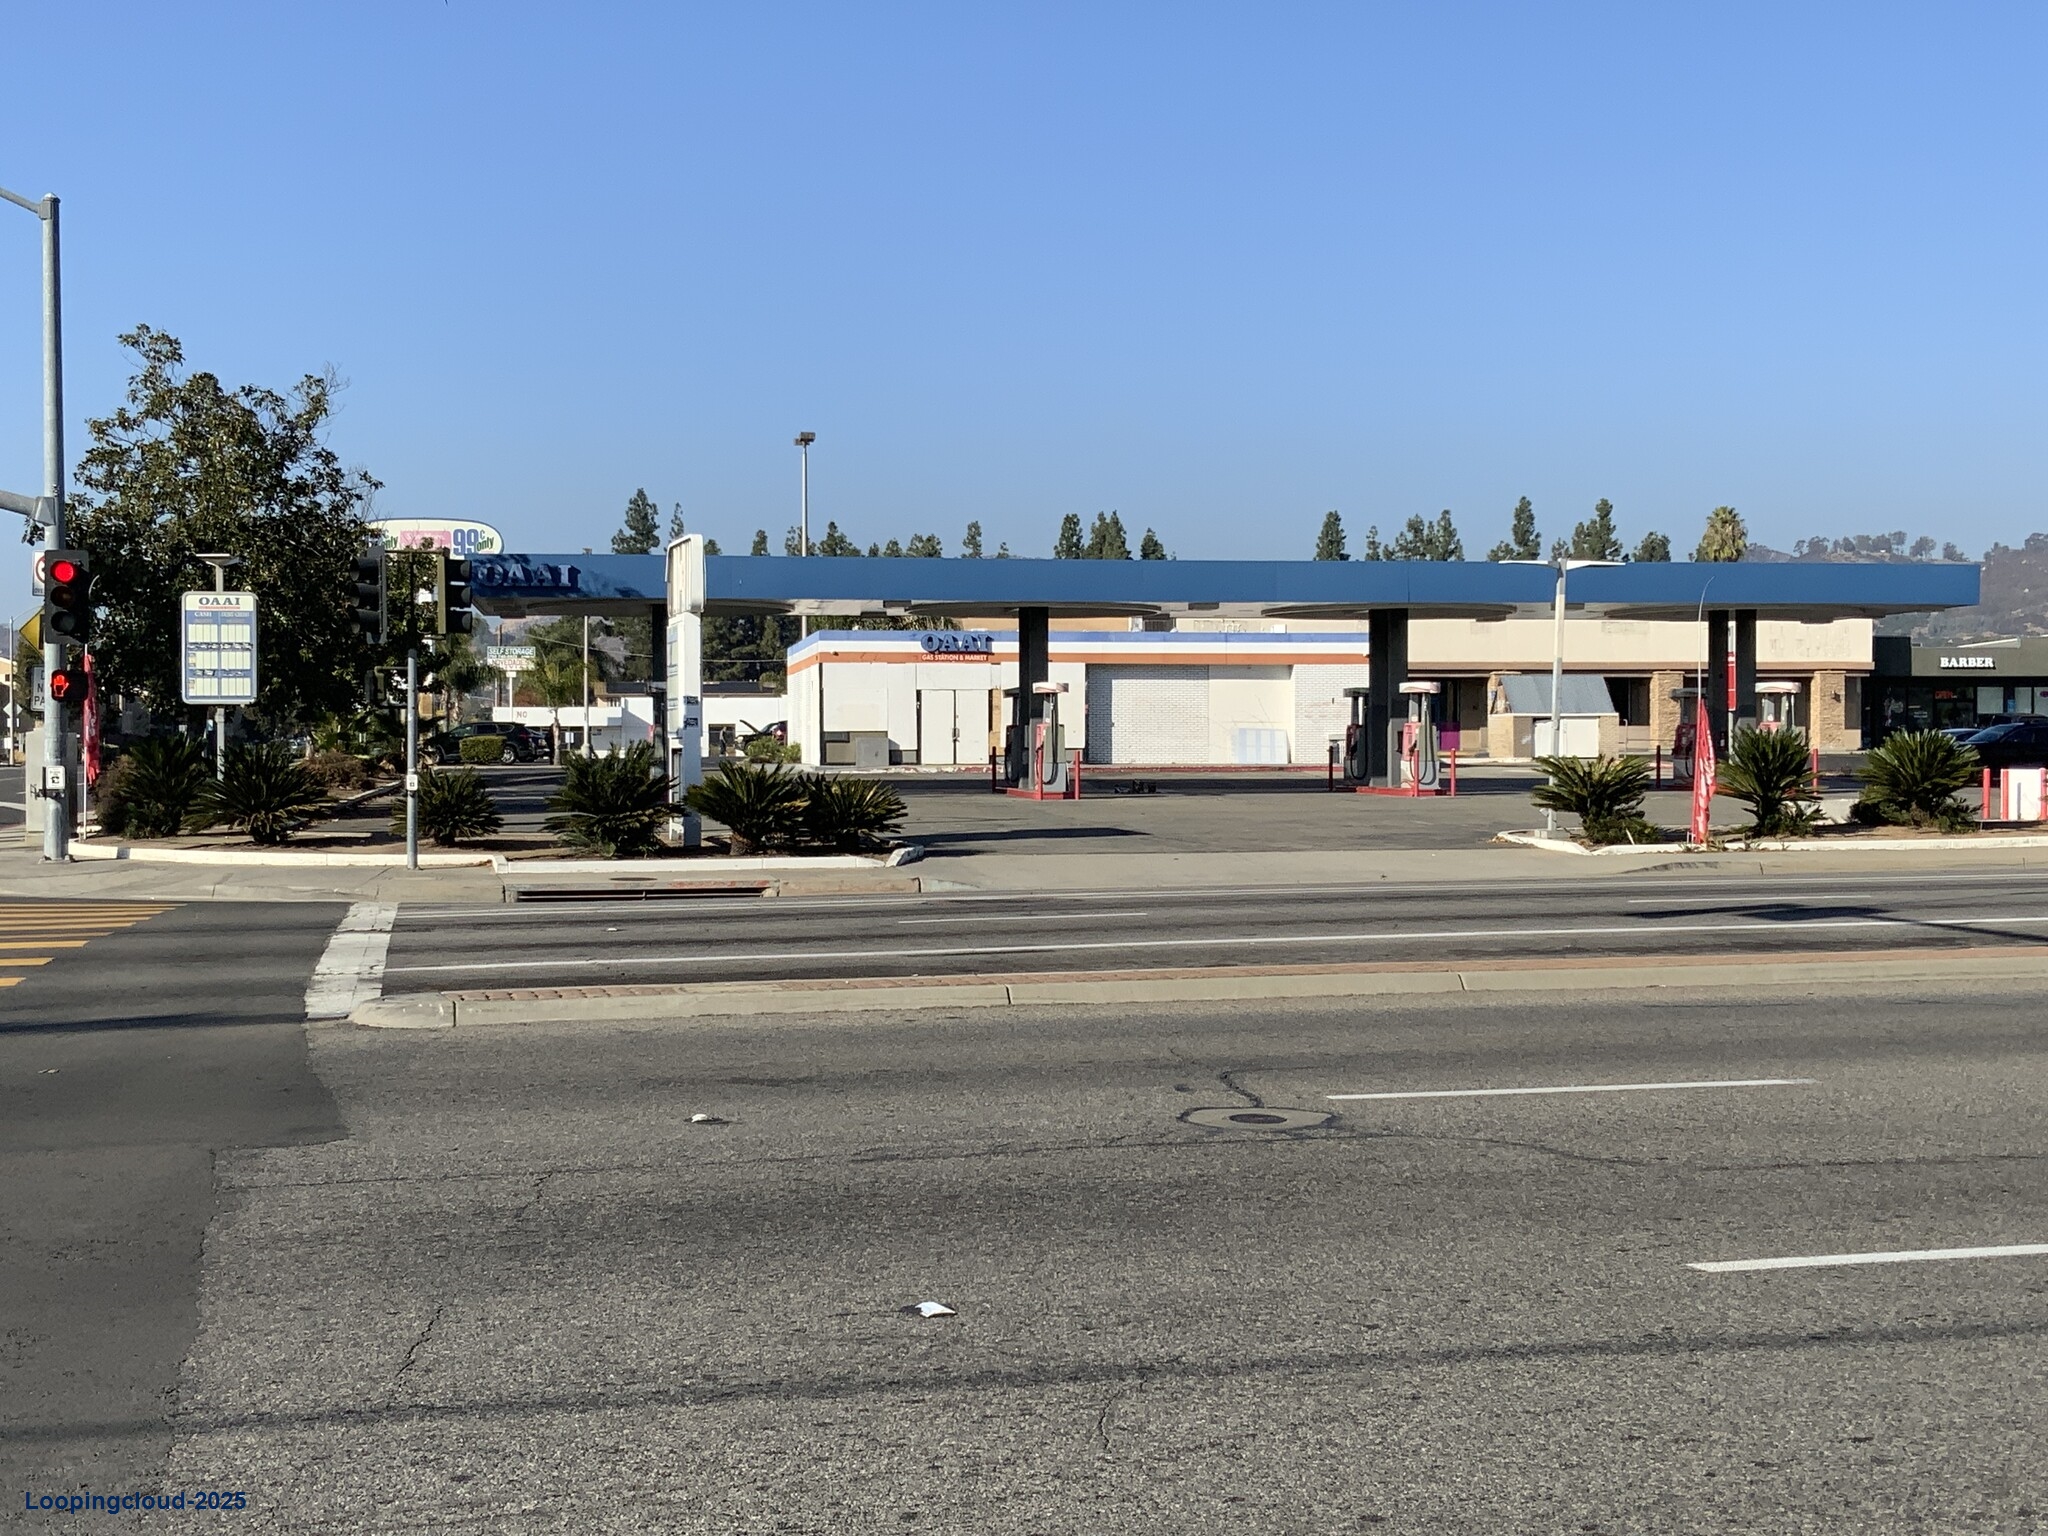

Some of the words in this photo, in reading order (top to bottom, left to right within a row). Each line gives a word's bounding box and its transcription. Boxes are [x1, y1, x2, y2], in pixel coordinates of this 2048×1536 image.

[476, 537, 494, 551] only
[478, 563, 572, 587] OAAI
[198, 597, 240, 605] OAAI
[921, 633, 989, 652] OAAI
[505, 648, 534, 656] STORAGE
[1940, 657, 1994, 668] BARBER
